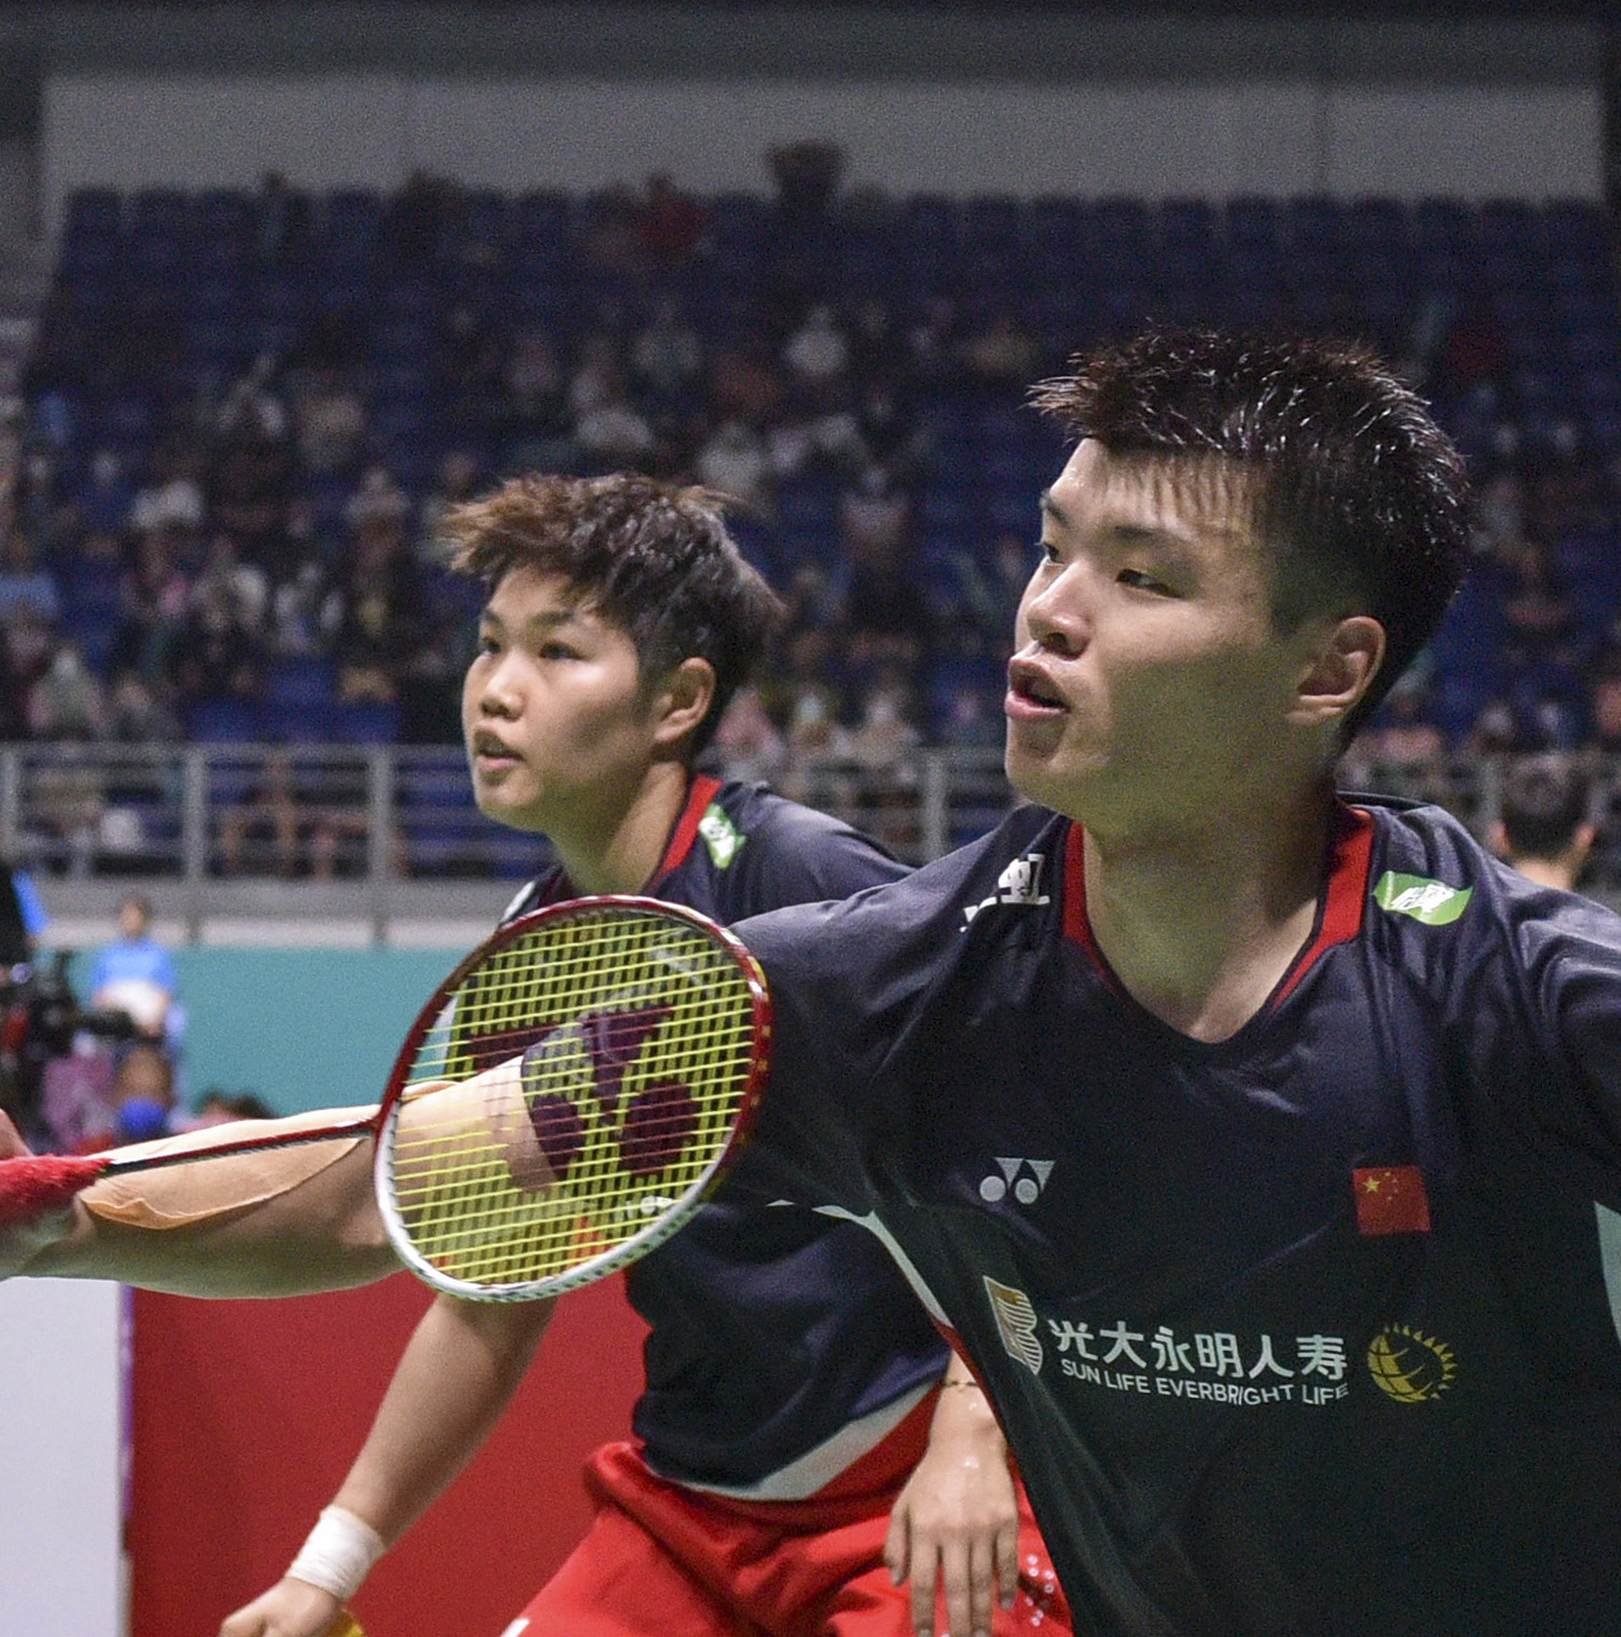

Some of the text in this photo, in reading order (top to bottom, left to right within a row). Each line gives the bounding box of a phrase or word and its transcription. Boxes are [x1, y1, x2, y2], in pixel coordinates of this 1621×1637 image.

[1048, 1319, 1348, 1380] 光大永明人寿
[1061, 1358, 1350, 1406] SUN LIFE EVERBRIGHT LIFE
